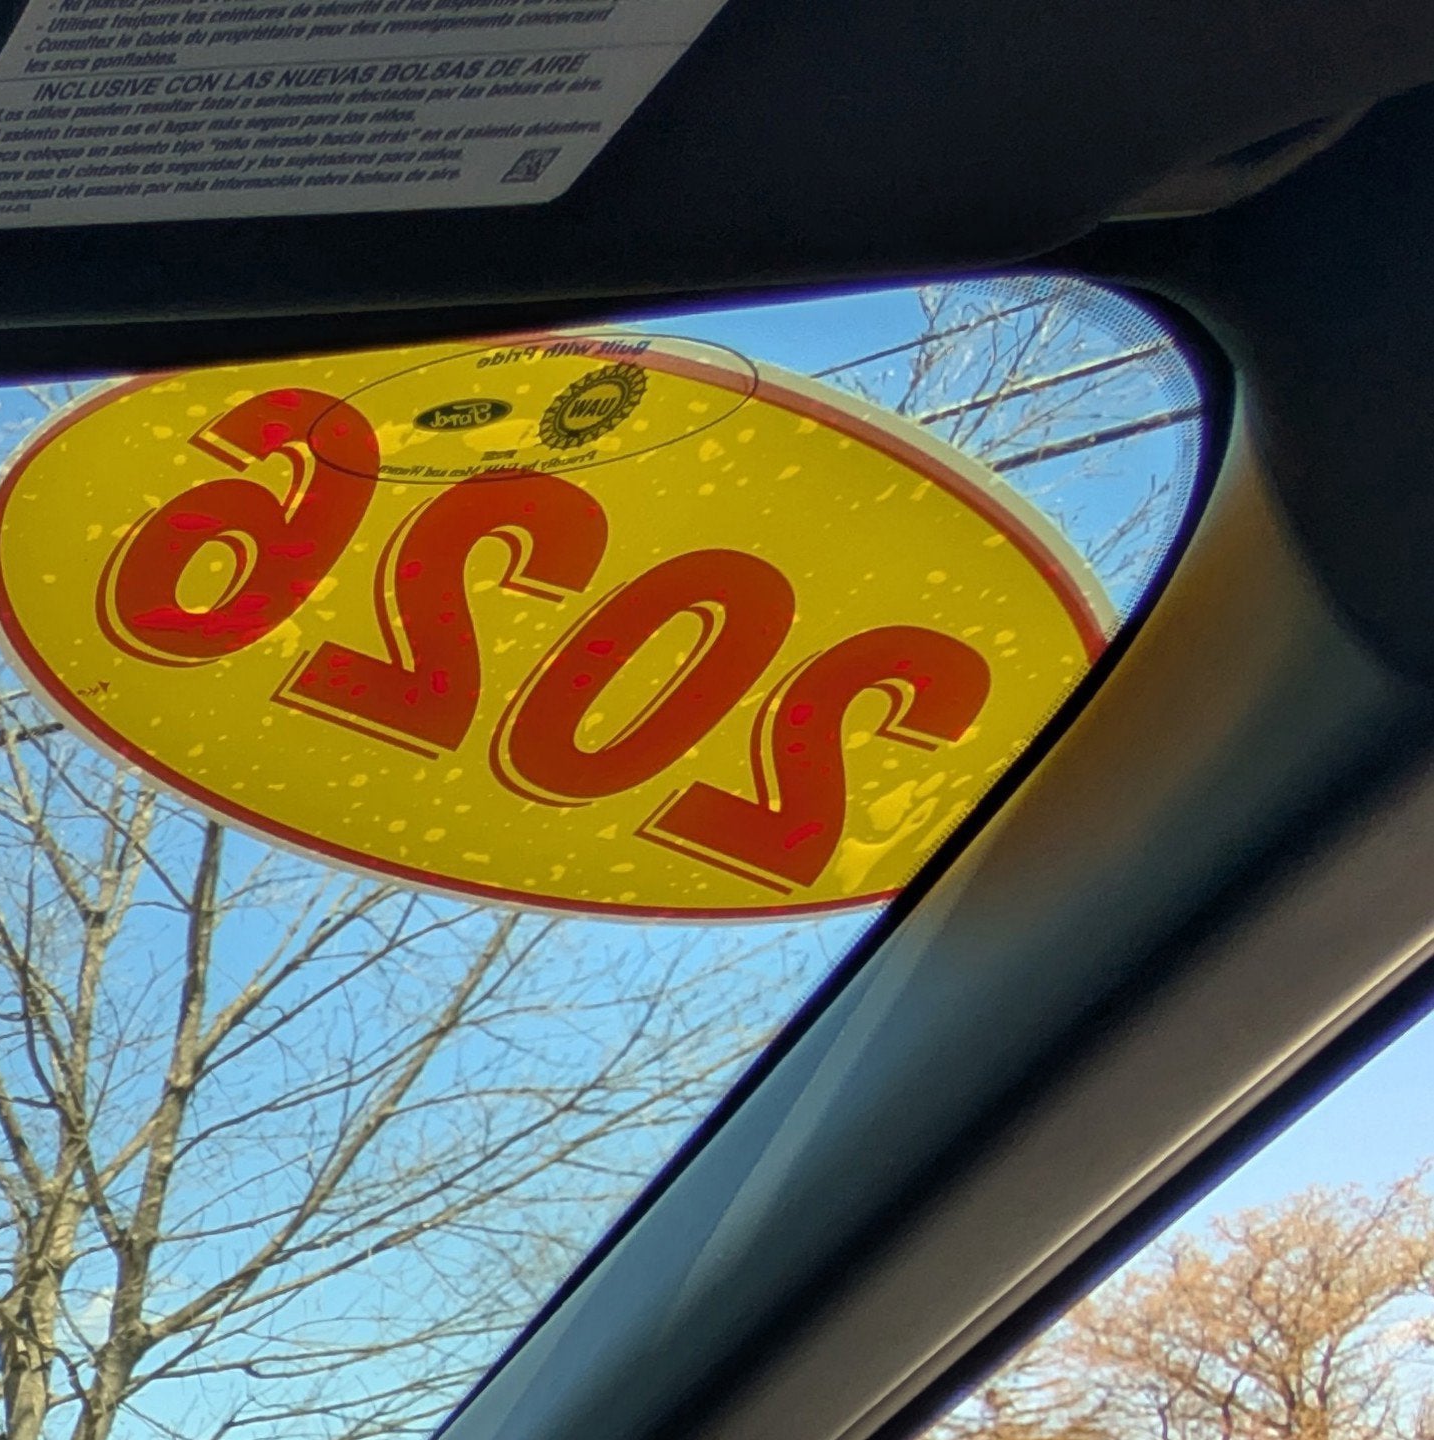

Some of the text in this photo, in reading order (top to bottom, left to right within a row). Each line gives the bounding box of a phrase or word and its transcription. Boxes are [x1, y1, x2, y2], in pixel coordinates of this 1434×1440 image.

[33, 53, 590, 102] INCLUSIVE CON LAS NUEVAS BOLSAS DE AIRE
